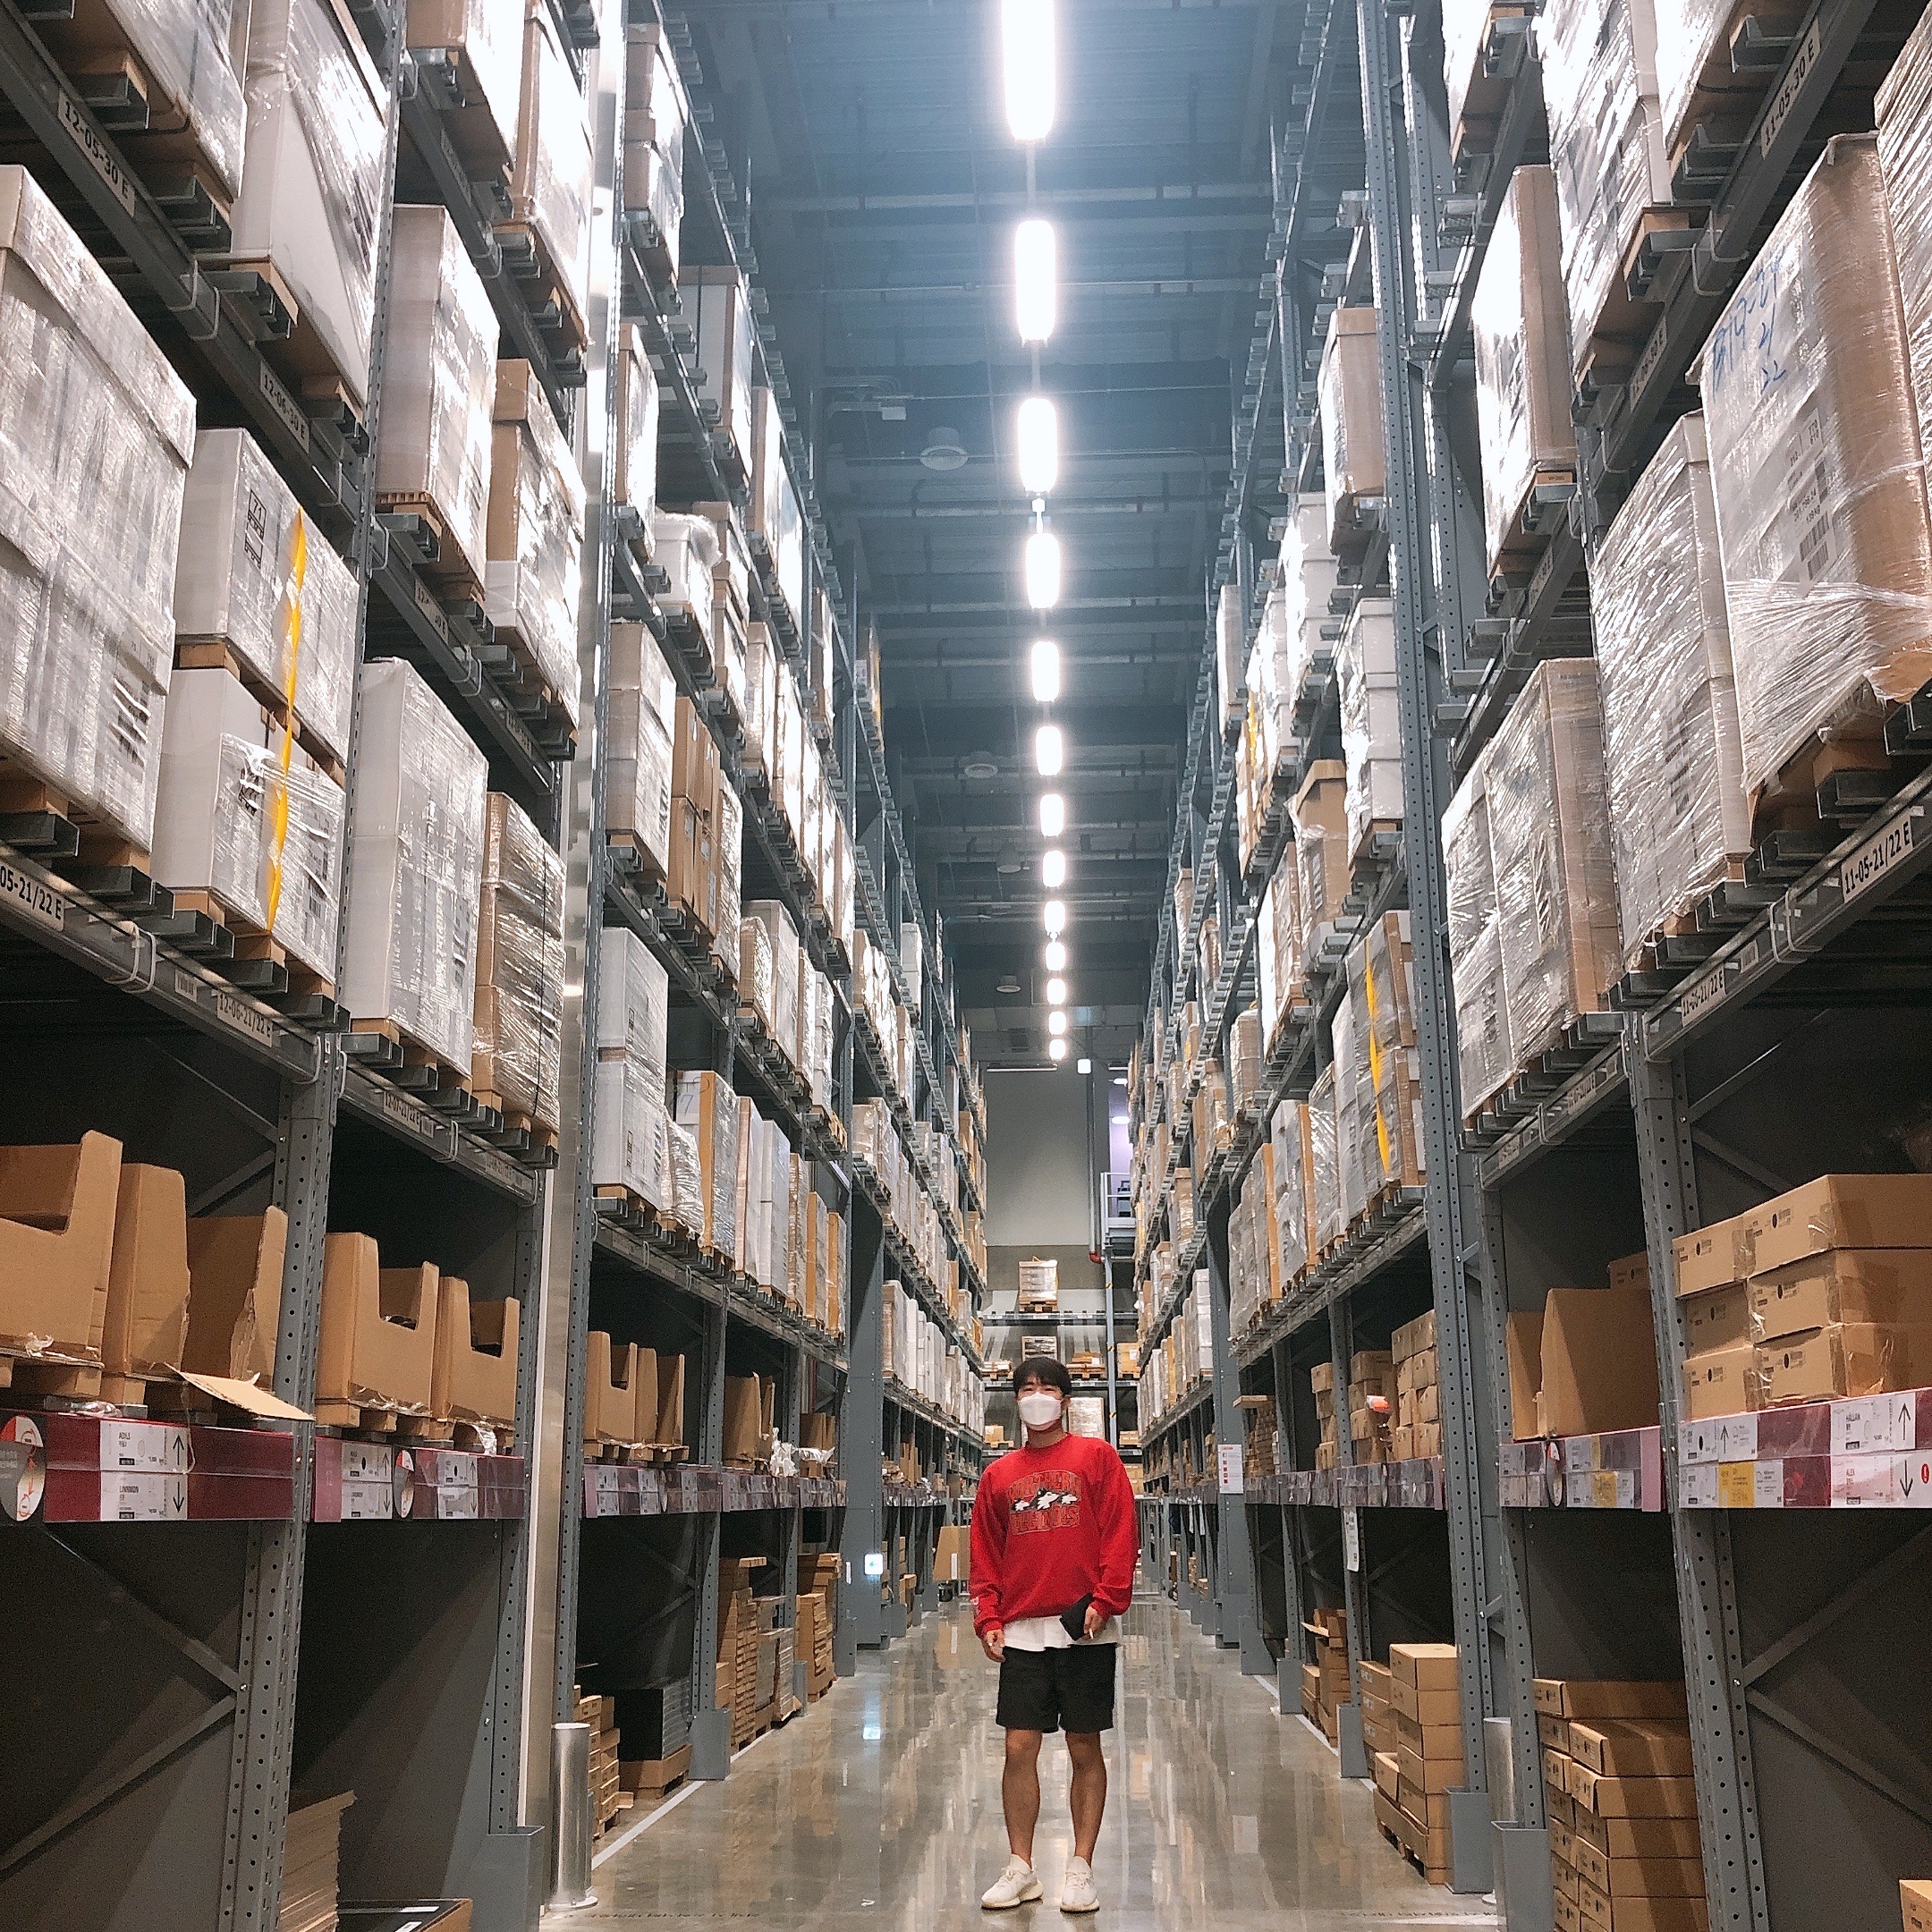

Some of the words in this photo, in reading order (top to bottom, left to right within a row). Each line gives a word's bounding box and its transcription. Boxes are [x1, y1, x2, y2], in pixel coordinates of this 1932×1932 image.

[1766, 56, 1806, 146] 11-05-30
[1808, 38, 1815, 63] E
[65, 101, 119, 184] 12-05-30
[121, 178, 129, 199] E
[264, 374, 299, 431] 12-06-30
[301, 423, 305, 440] E
[1844, 828, 1902, 894] 11-05-21/22
[1902, 820, 1911, 846] E
[0, 865, 53, 915] 05-21/22
[55, 898, 63, 921] E
[219, 992, 265, 1035] 12-06-21/22
